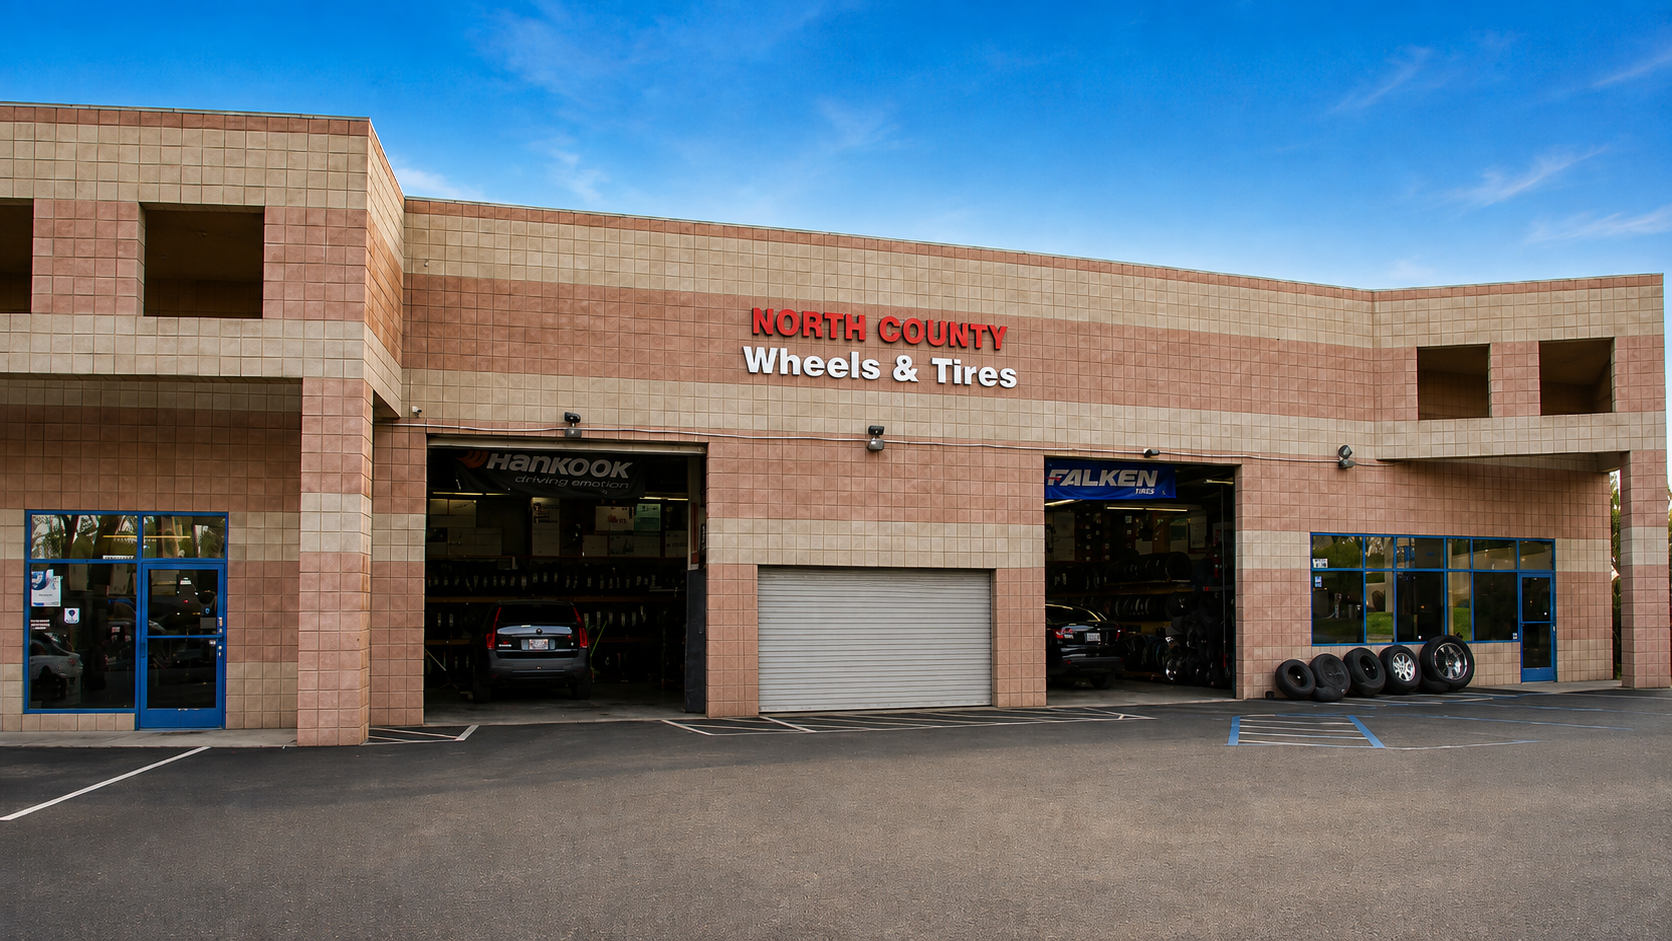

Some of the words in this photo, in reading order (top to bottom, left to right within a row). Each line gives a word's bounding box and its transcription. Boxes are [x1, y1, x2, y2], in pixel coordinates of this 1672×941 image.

[752, 307, 867, 342] NORTH
[878, 315, 1008, 350] COUNTY
[742, 345, 881, 380] Wheels
[892, 354, 919, 383] &
[931, 357, 1018, 389] Tires
[514, 474, 570, 488] driving
[571, 479, 629, 490] emotion
[1047, 469, 1159, 487] FALKEN
